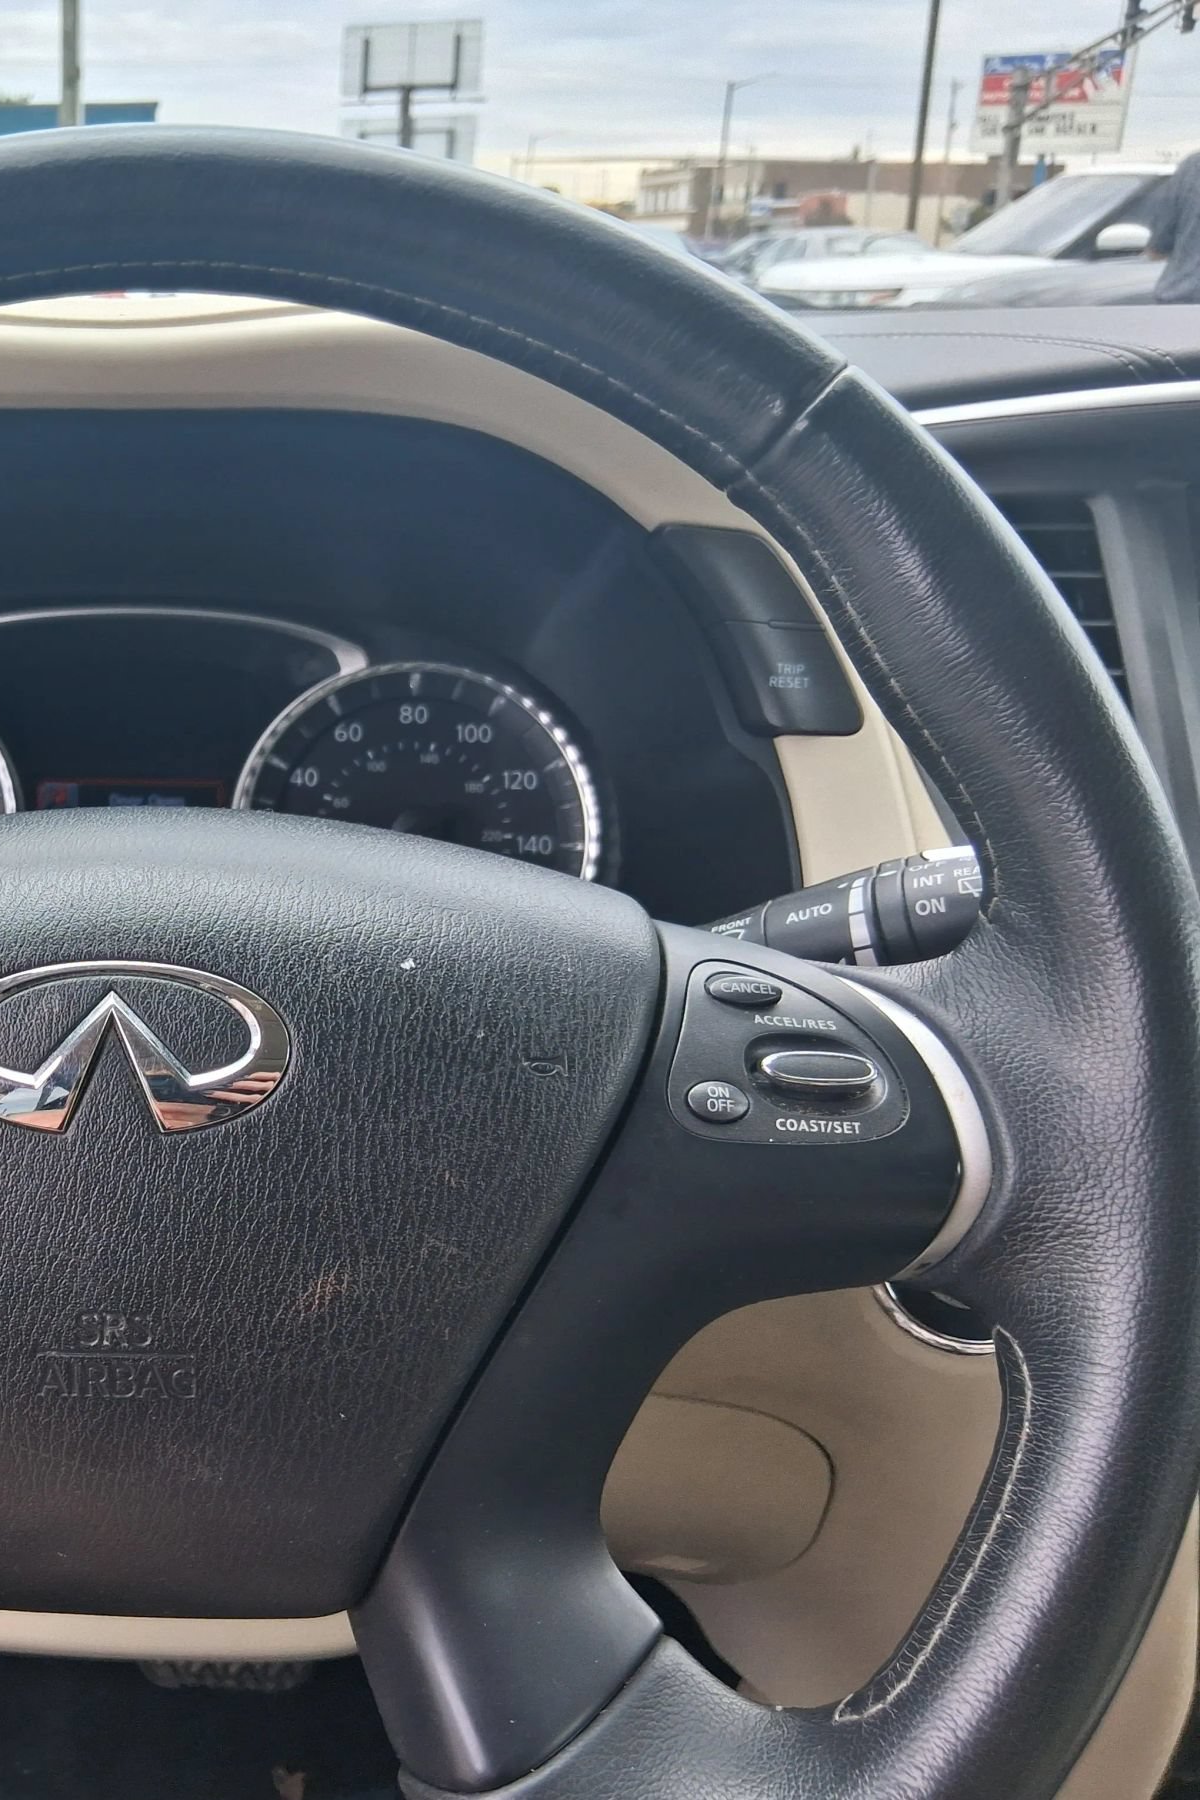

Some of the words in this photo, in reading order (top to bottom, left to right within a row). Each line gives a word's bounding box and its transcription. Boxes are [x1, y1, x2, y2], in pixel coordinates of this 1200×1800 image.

[776, 663, 806, 674] TRIP
[768, 676, 810, 688] RESET
[399, 705, 428, 724] 80
[334, 723, 363, 742] 60
[456, 723, 492, 743] 100
[290, 768, 319, 787] 40
[503, 770, 538, 790] 120
[516, 835, 552, 855] 140
[953, 866, 981, 877] REA
[912, 873, 945, 889] INT
[785, 903, 833, 925] AUTO
[915, 896, 947, 916] ON
[711, 916, 753, 933] FRONT
[720, 981, 777, 996] CANCEL
[753, 1014, 837, 1031] ACCEL/RES
[706, 1085, 731, 1099] ON
[705, 1098, 735, 1113] OFF
[775, 1118, 862, 1135] COAST/SET
[75, 1310, 154, 1348] SRS
[36, 1360, 197, 1400] AIRBAG
